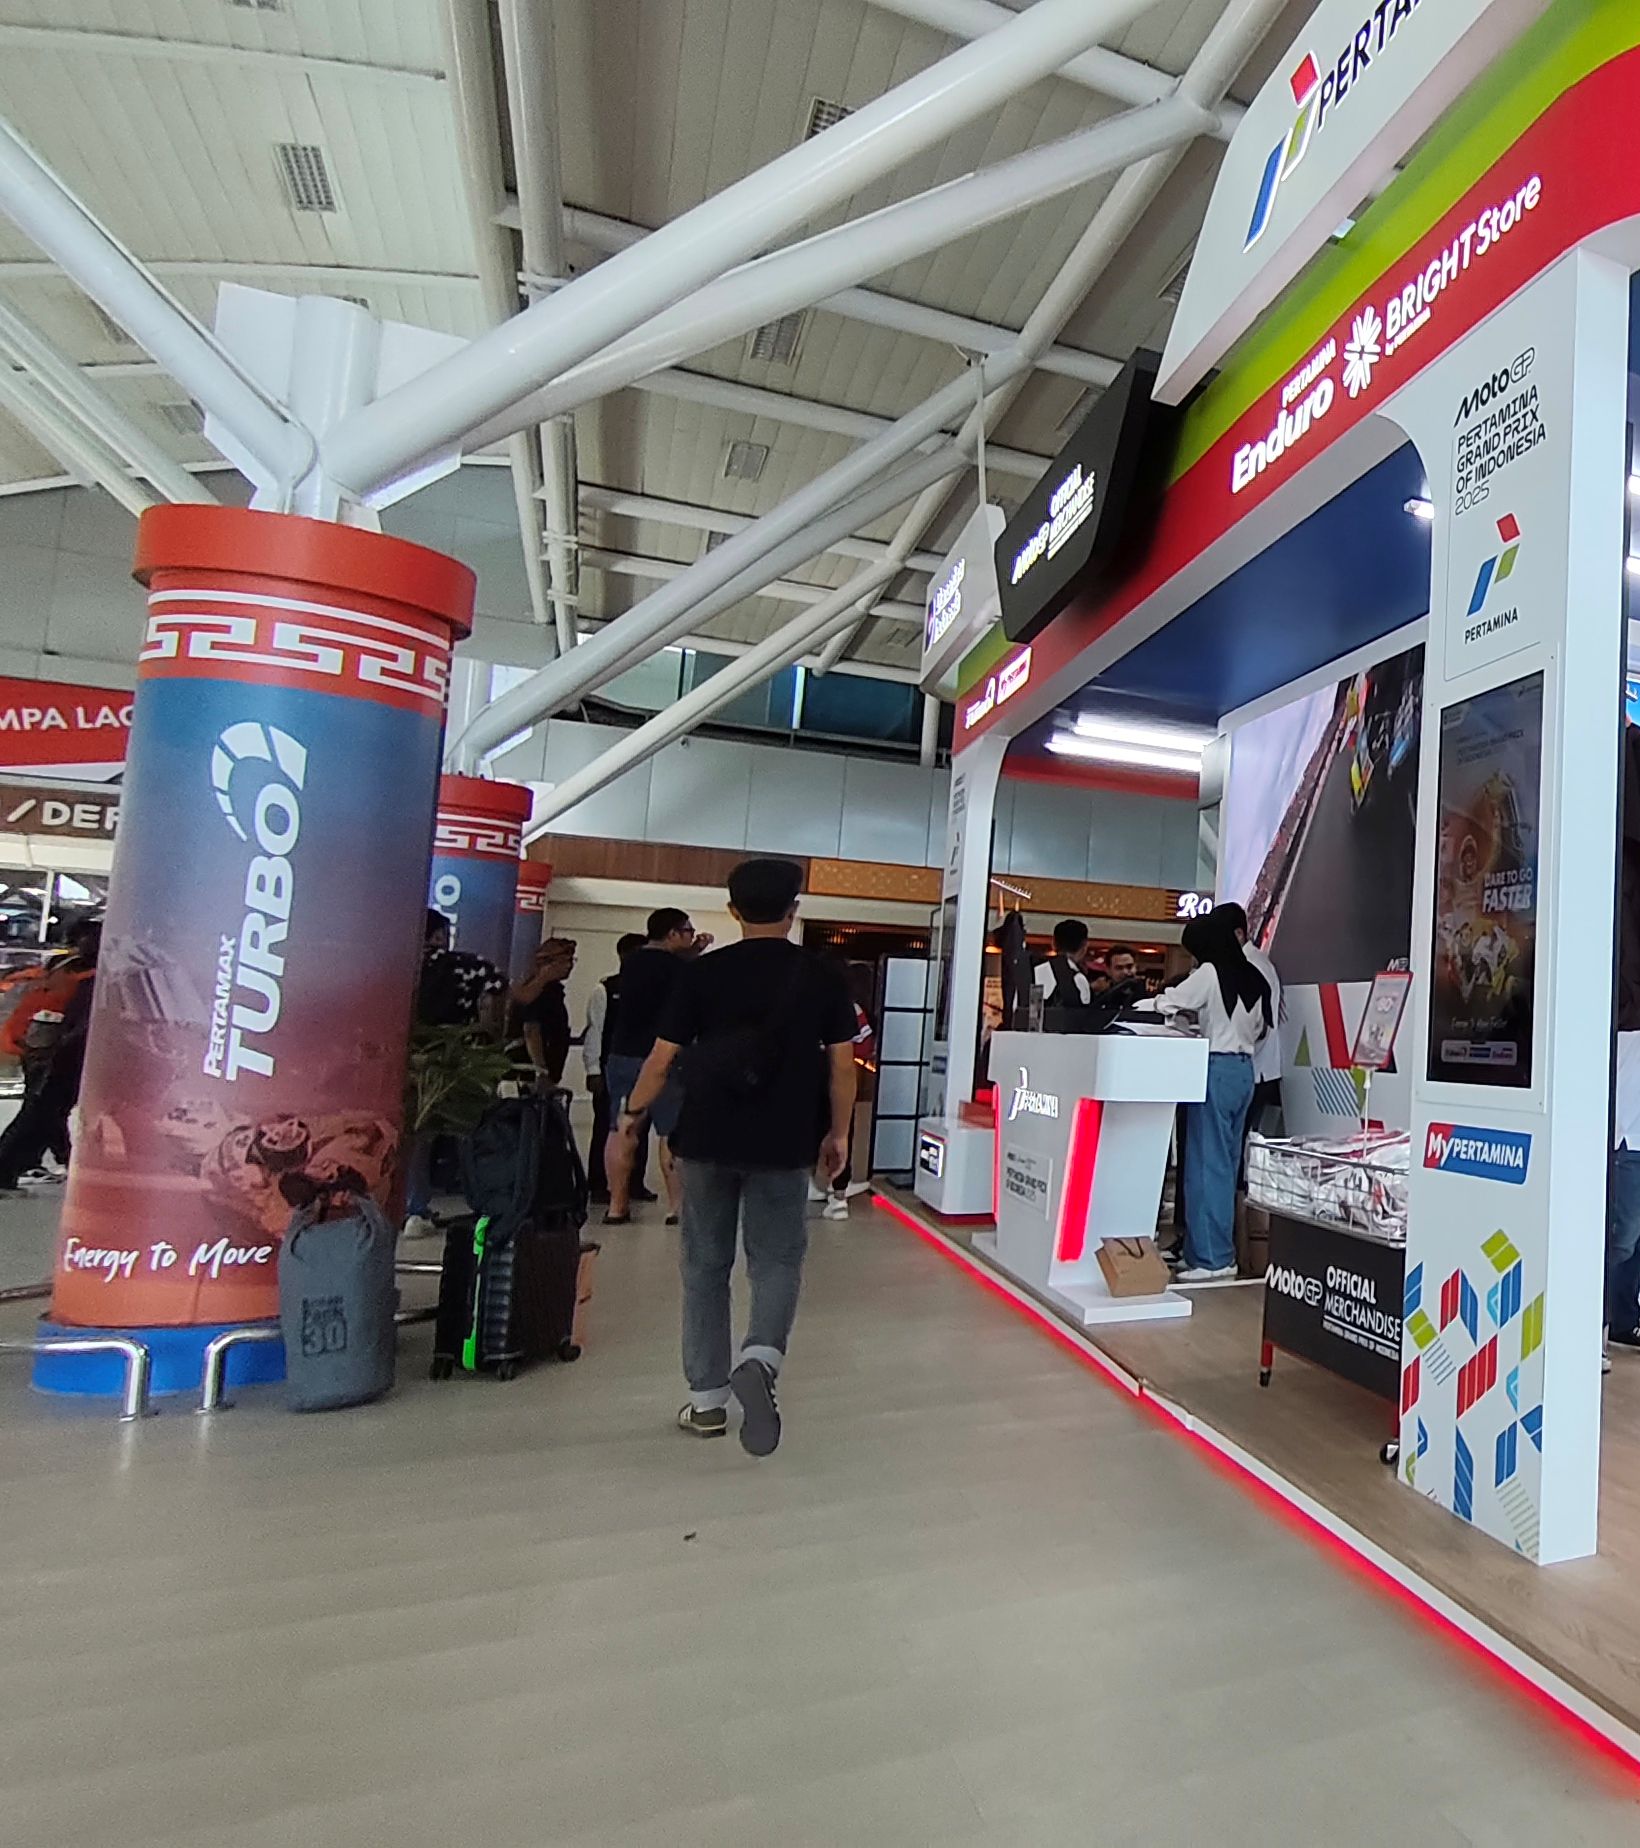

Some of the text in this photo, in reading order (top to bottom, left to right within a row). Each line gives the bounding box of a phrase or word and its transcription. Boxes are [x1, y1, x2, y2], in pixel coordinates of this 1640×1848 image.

[1317, 0, 1421, 131] PERTA
[1231, 376, 1335, 495] Enduro
[1456, 404, 1540, 474] GRAND PRIX
[1457, 384, 1539, 454] PERTAMINA
[1456, 423, 1547, 495] OF INDONESIA
[1454, 480, 1490, 516] 2025
[1464, 607, 1519, 645] PERTAMINA
[1482, 883, 1533, 912] FASTER
[1507, 870, 1518, 883] TO
[1519, 867, 1533, 881] GO
[225, 783, 300, 1081] TURBO
[203, 934, 237, 1079] PERTAMAX
[63, 1236, 273, 1284] Energy to Move
[1326, 1265, 1377, 1304] OFFICIAL
[1324, 1291, 1401, 1342] MERCHANDISE
